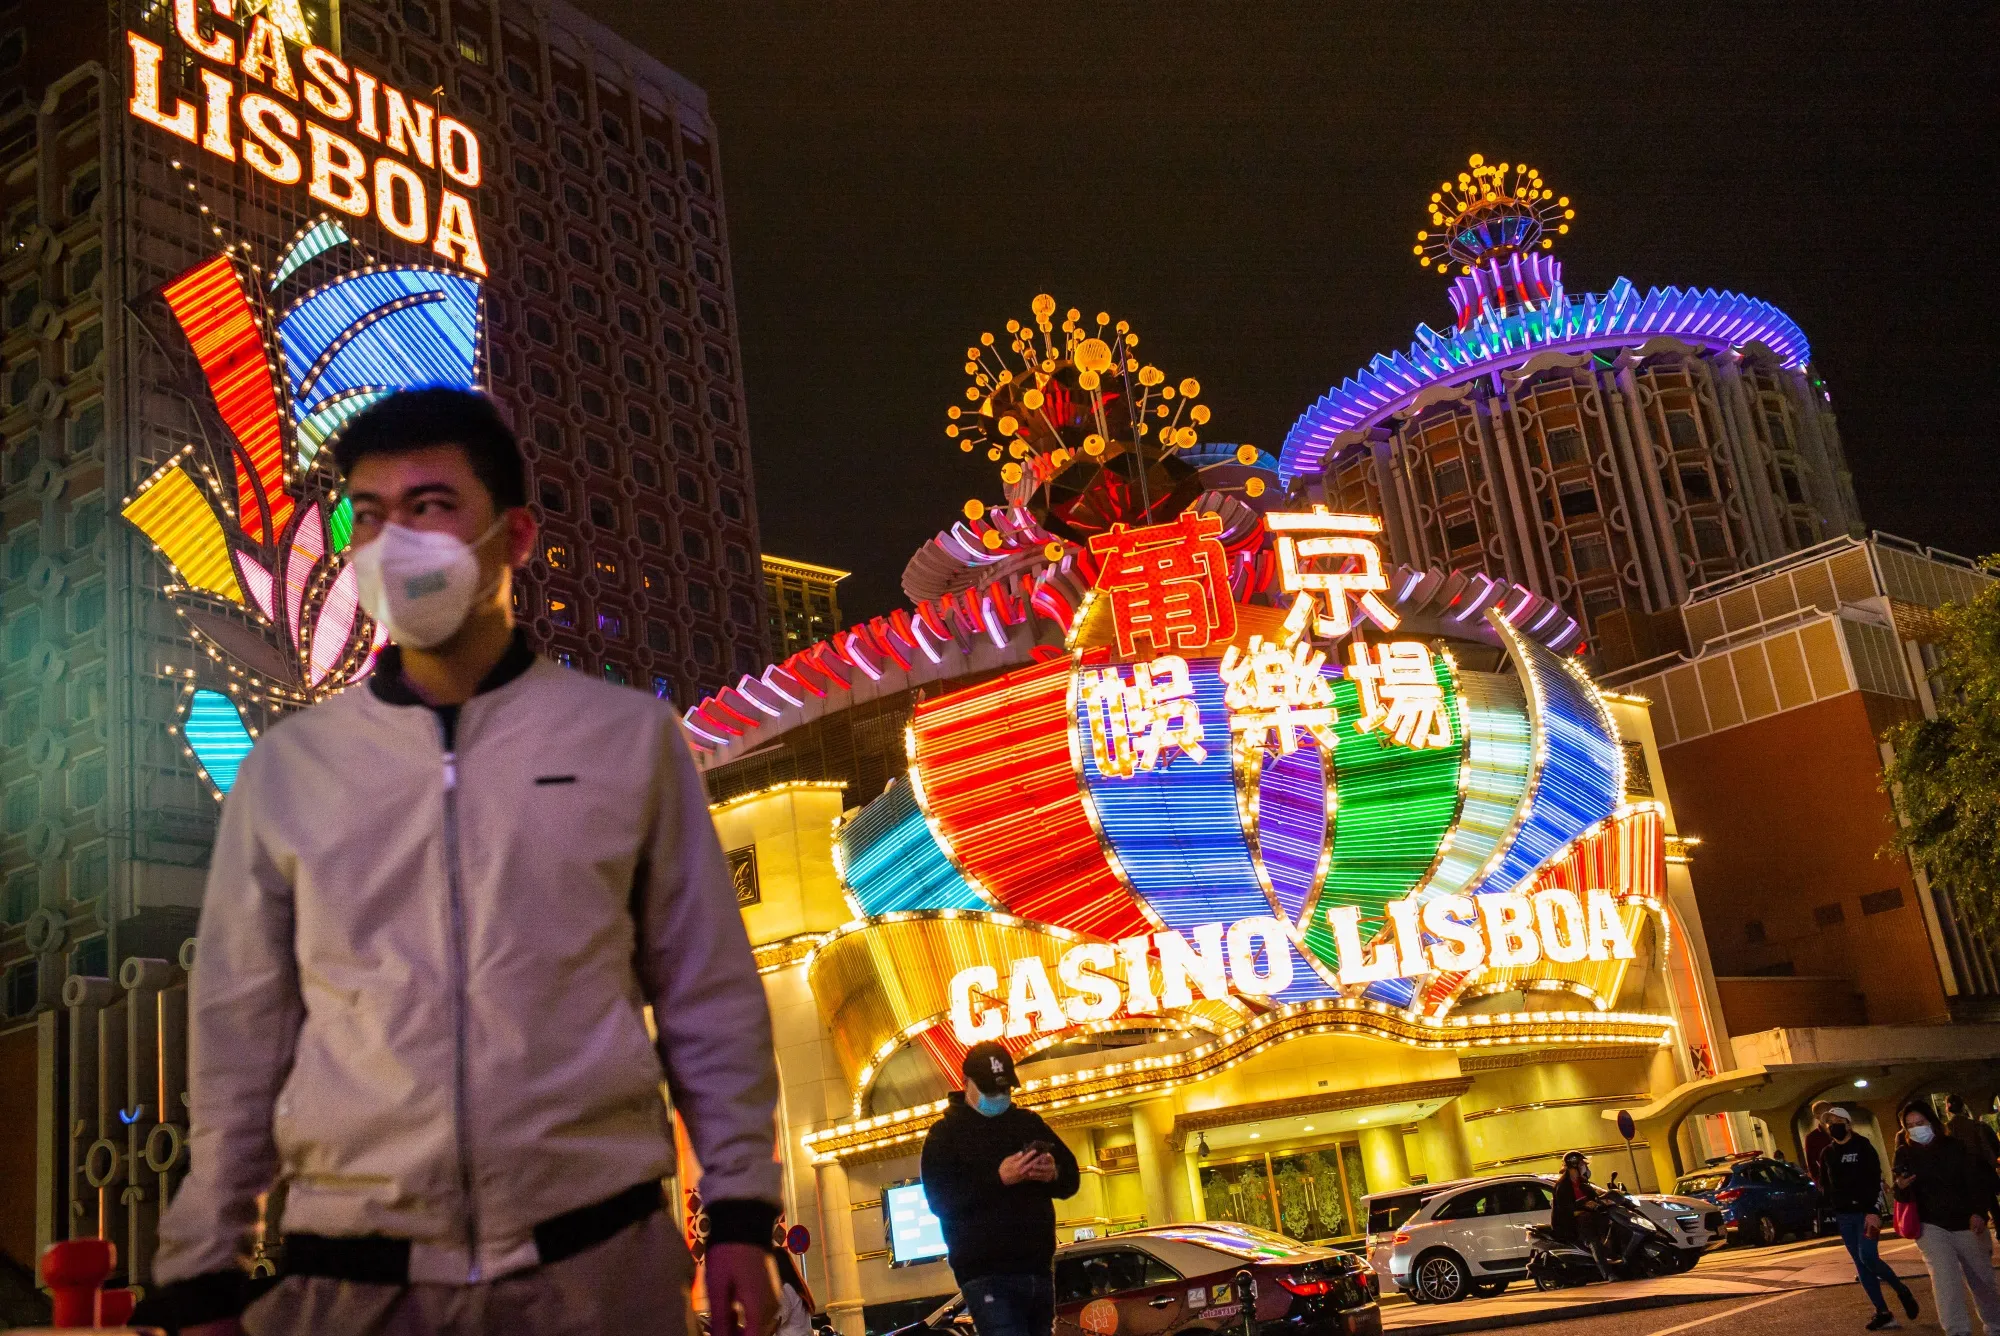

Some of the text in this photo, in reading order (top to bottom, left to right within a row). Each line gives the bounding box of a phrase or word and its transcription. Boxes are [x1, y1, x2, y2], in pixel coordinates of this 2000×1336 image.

[174, 0, 482, 189] CASINO
[127, 30, 489, 277] LISBOA
[1088, 504, 1401, 658] 葡京
[948, 888, 1637, 1047] CASINO LISBOA
[989, 1056, 1004, 1073] LA
[1085, 1314, 1110, 1333] Spa
[1092, 1302, 1114, 1319] Rio
[1188, 1289, 1204, 1301] 24
